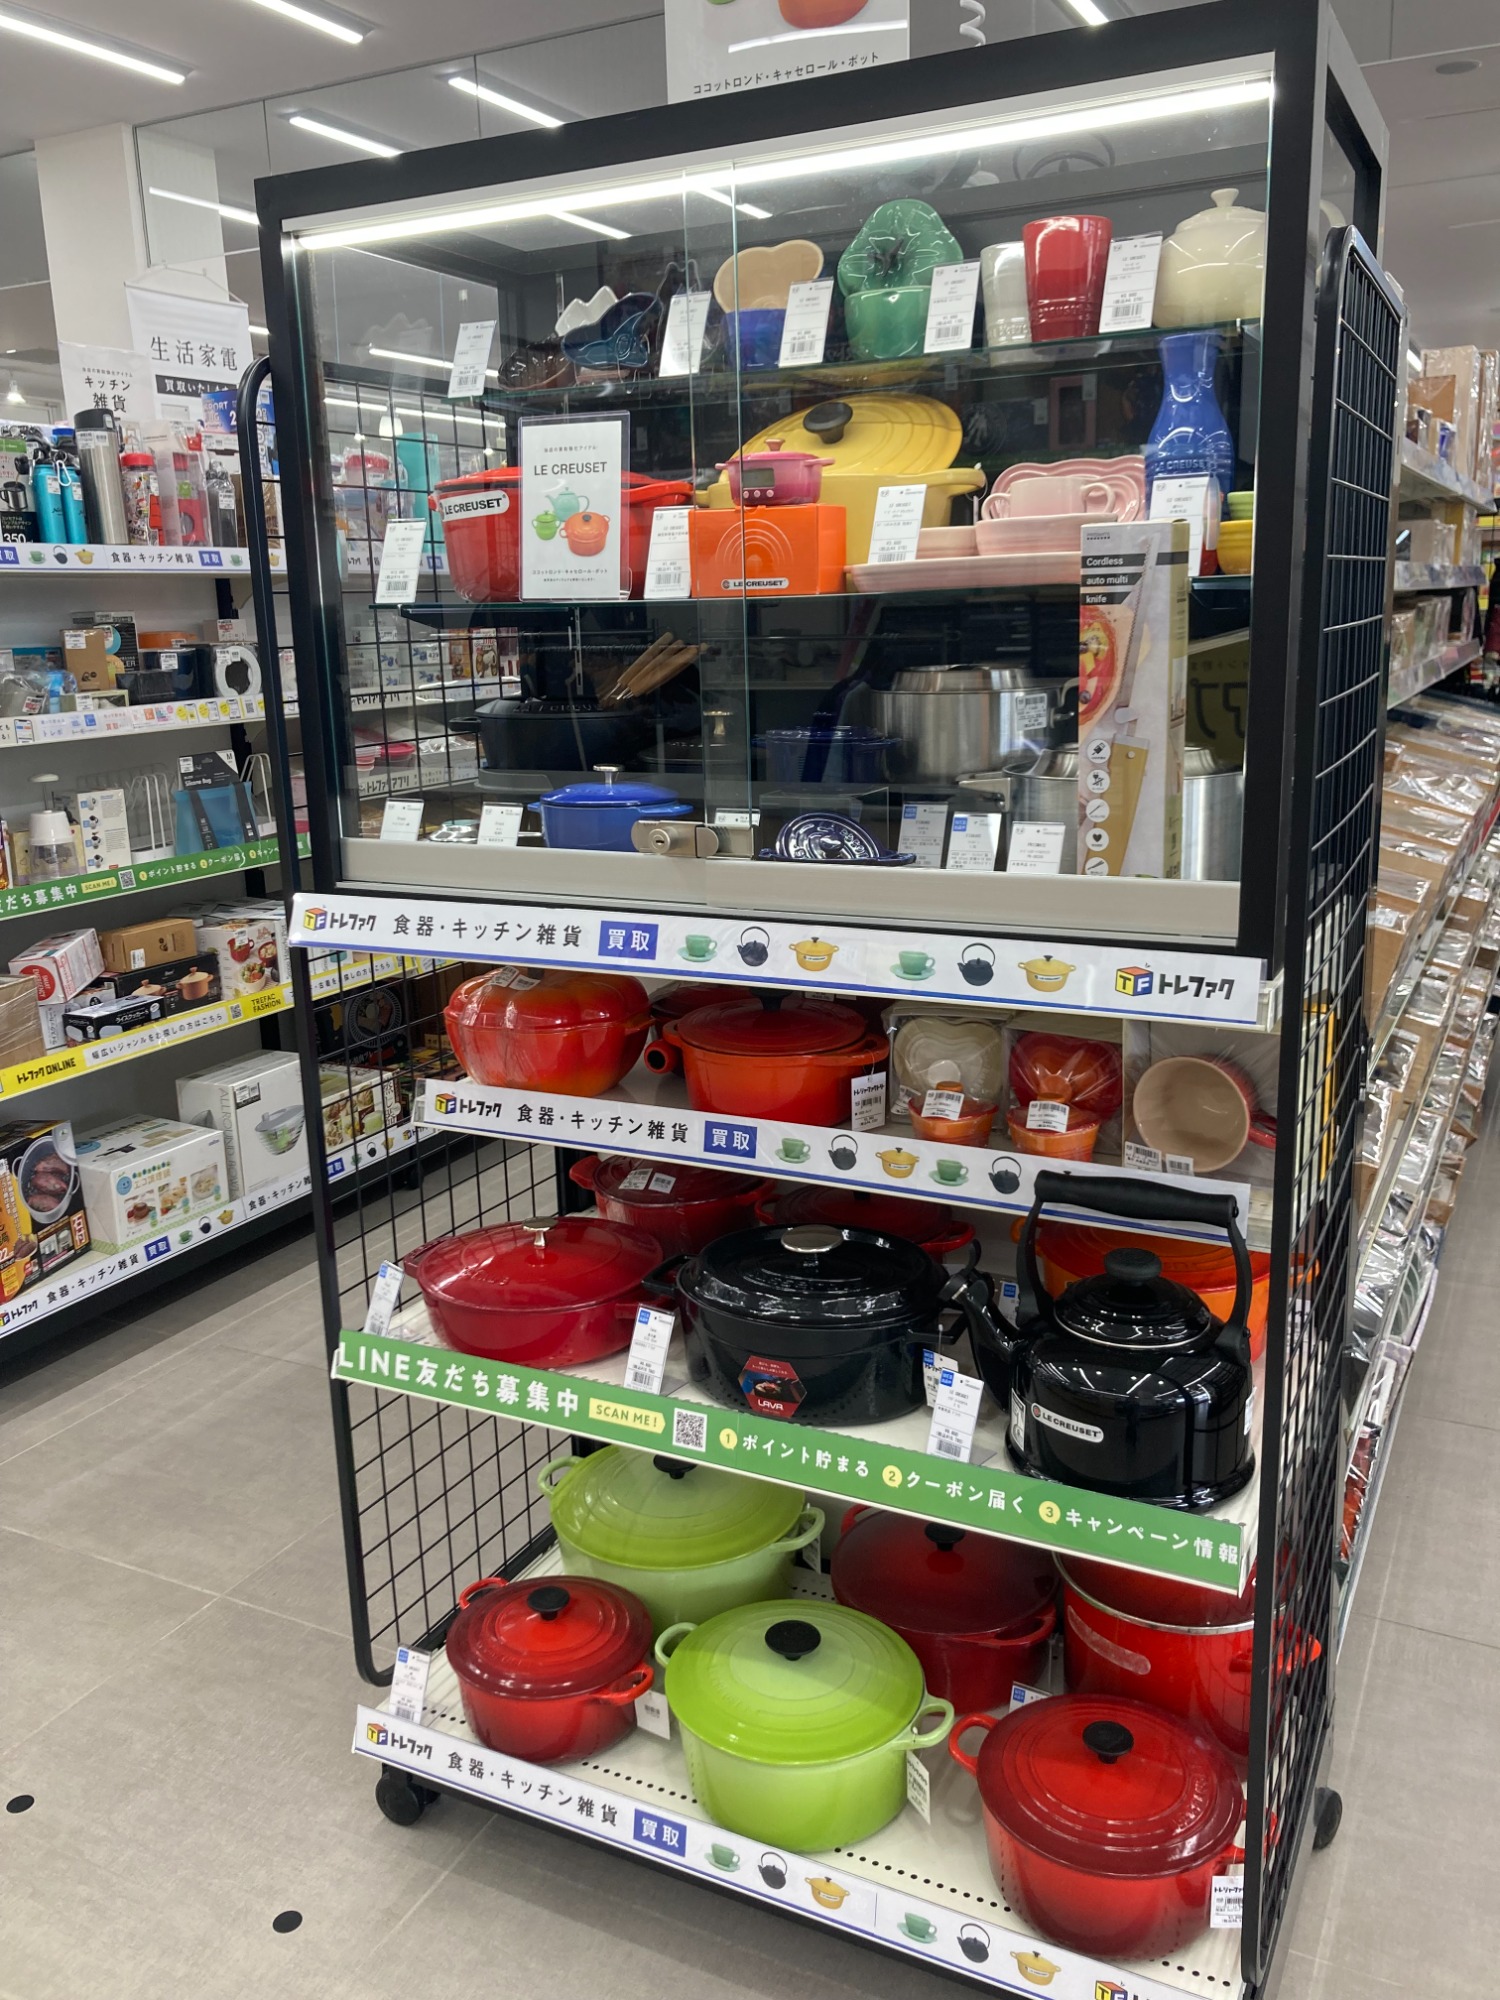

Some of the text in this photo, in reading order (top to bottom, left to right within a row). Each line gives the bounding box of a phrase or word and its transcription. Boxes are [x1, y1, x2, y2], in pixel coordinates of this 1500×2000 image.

[150, 336, 238, 371] 生活家電
[84, 375, 131, 391] キッチン
[93, 392, 127, 413] 雑貨
[534, 461, 608, 476] LE CREUSET
[444, 497, 503, 516] LE CREUSET
[111, 551, 220, 565] 食器・キッチン雑貨 買取
[1086, 556, 1124, 567] Cordless
[746, 579, 784, 587] CREUSET
[1086, 574, 1128, 585] auto multi
[1086, 594, 1107, 604] knife
[366, 775, 410, 793] トレファアプリ
[148, 861, 197, 878] ポイント貯まる
[84, 881, 101, 891] SCAN
[329, 912, 377, 932] トレファク
[393, 913, 583, 949] 食器・キッチン雑貨
[607, 927, 651, 953] 買取
[1158, 973, 1236, 1001] トレファク
[251, 993, 276, 1006] TREFAC
[253, 999, 281, 1013] FASHION
[16, 1062, 45, 1085] トレファク
[45, 1057, 77, 1075] ONLINE
[218, 1087, 235, 1156] ALLROUND
[459, 1099, 503, 1118] トレファク
[517, 1103, 689, 1144] 食器・キッチン雑貨
[711, 1127, 751, 1151] 買取
[11, 1300, 39, 1320] トレファク
[47, 1253, 140, 1305] 食器・キッチン雑貨
[148, 1240, 168, 1258] 買取
[757, 1398, 785, 1411] LAVA
[1042, 1411, 1099, 1439] LE CREUSET
[595, 1403, 628, 1421] SCAN
[742, 1434, 869, 1479] ポイント貯まる
[907, 1471, 1024, 1515] クーポン届く
[1065, 1507, 1239, 1566] キャンペーン情報
[391, 1732, 433, 1760] トレファク
[447, 1751, 619, 1827] 食器・キッチン雑貨
[641, 1818, 680, 1848] 買取
